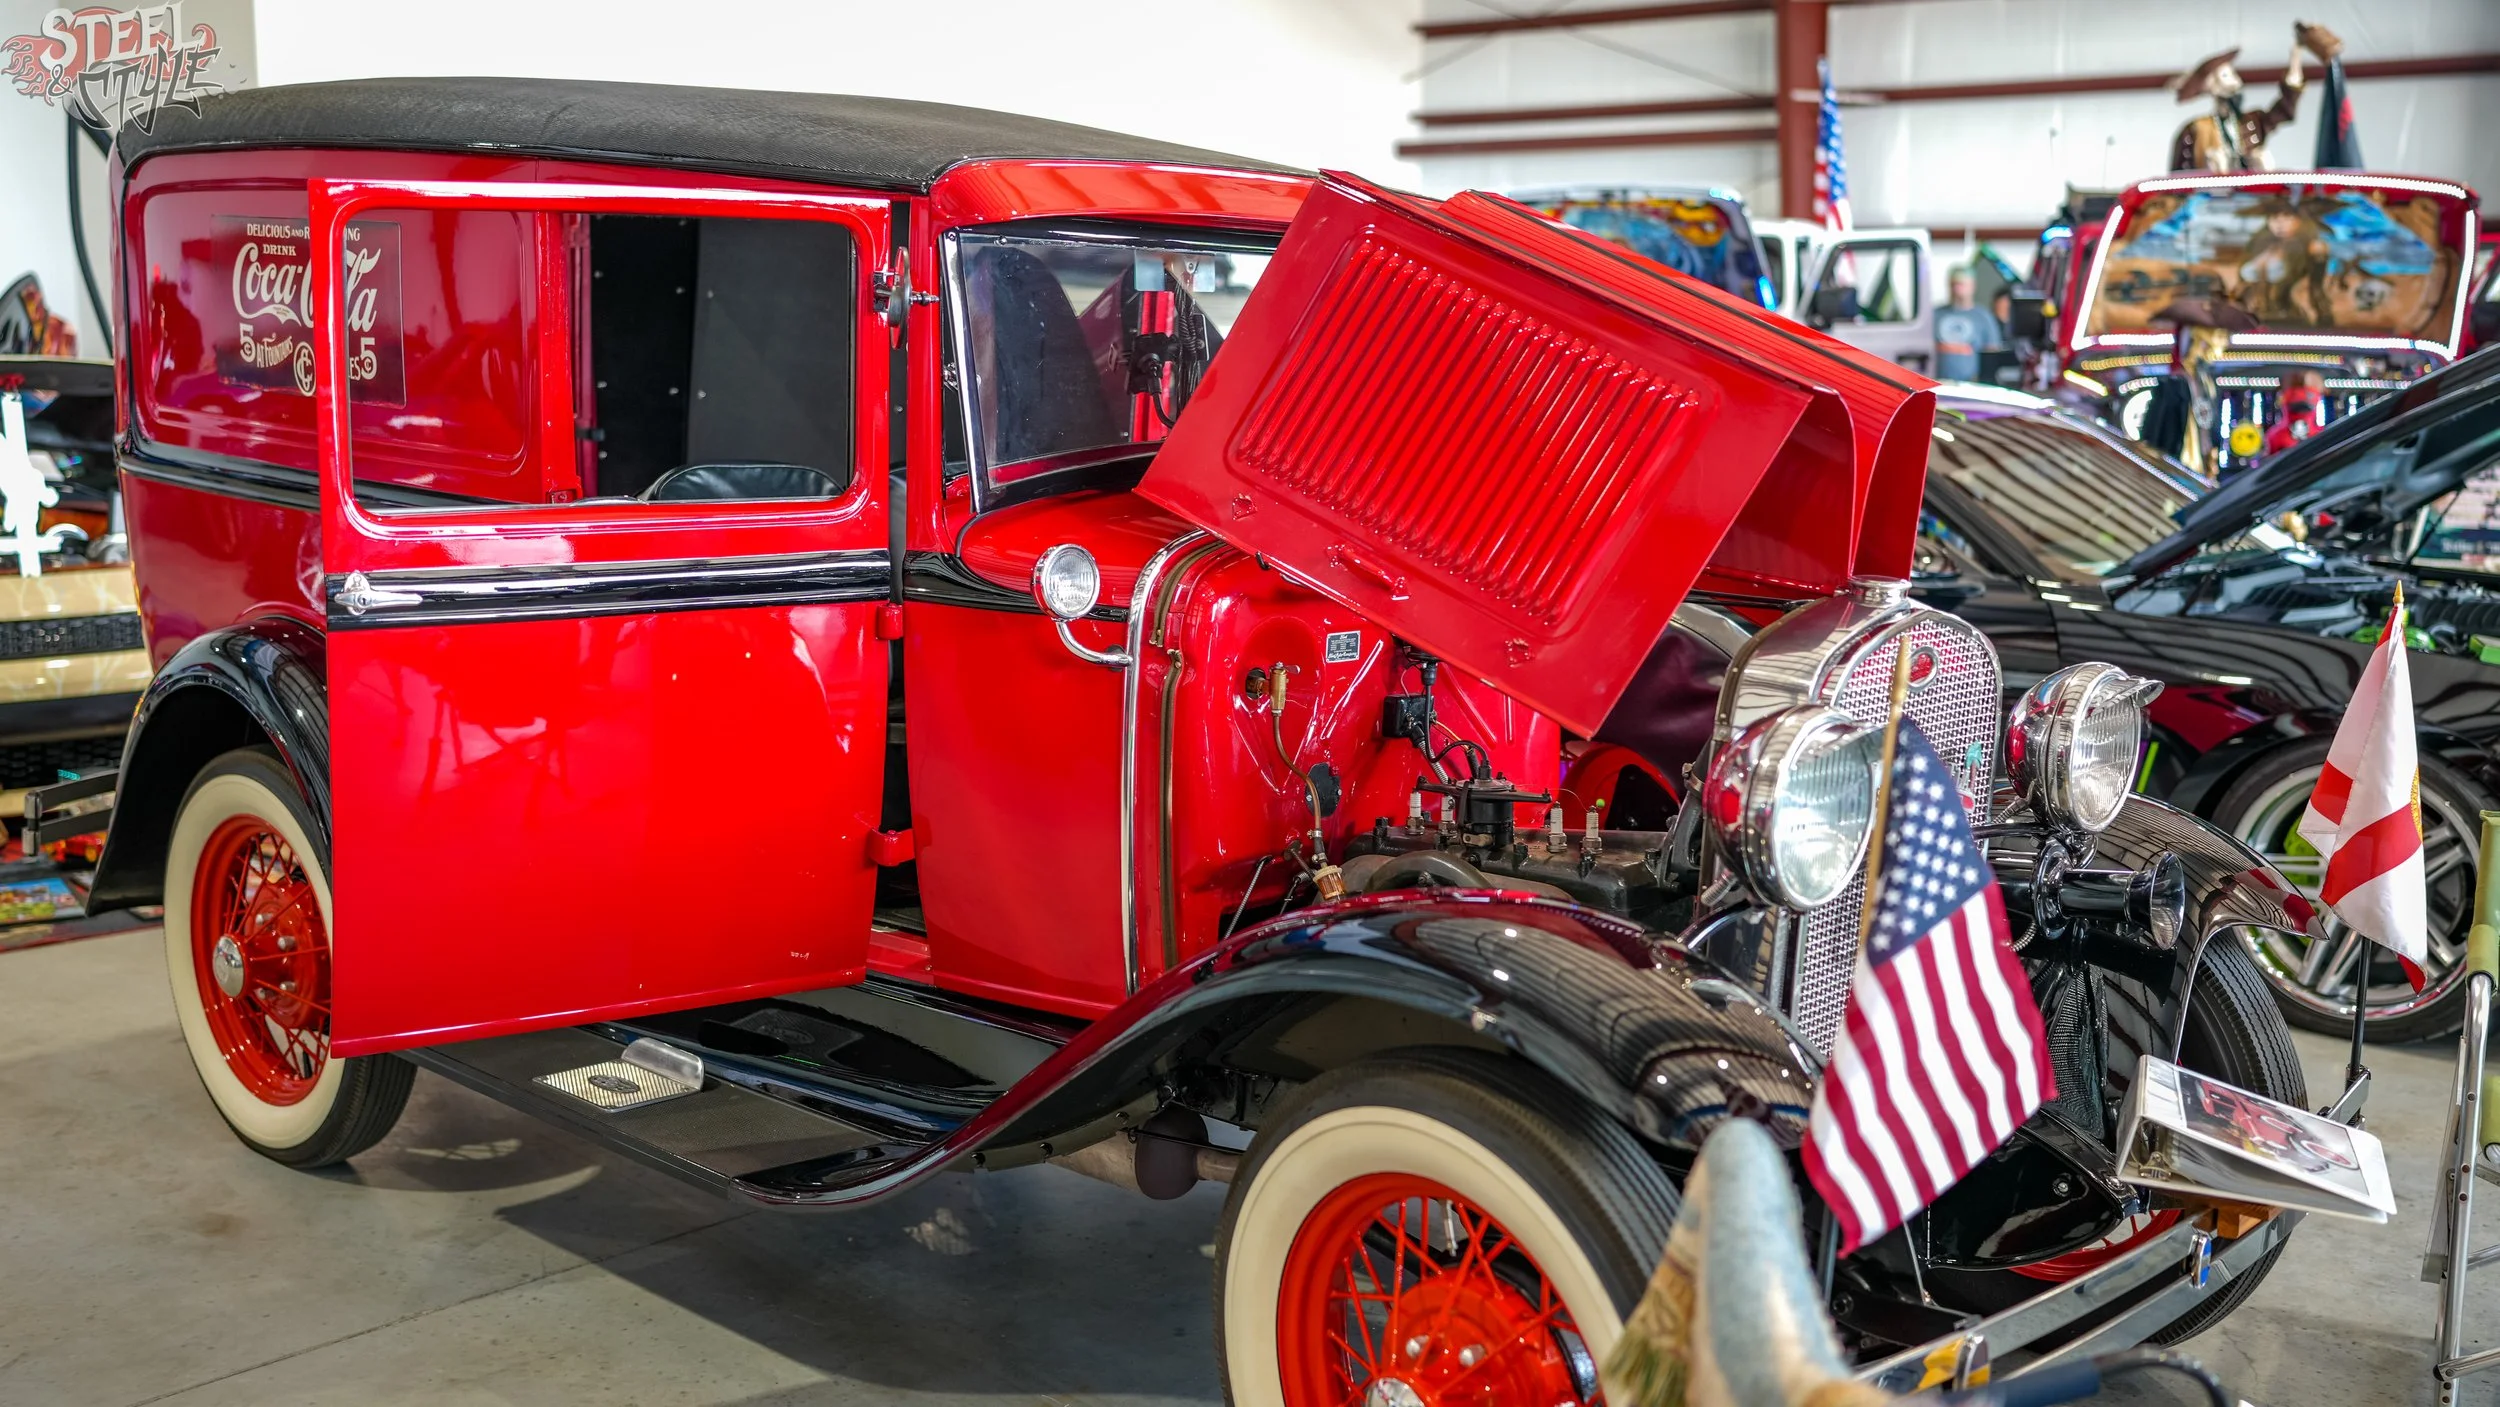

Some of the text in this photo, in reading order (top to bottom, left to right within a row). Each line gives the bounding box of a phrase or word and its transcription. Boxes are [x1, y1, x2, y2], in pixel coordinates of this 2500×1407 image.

[247, 223, 291, 239] DELICIOUS
[291, 228, 304, 238] AND
[262, 243, 297, 257] DRINK
